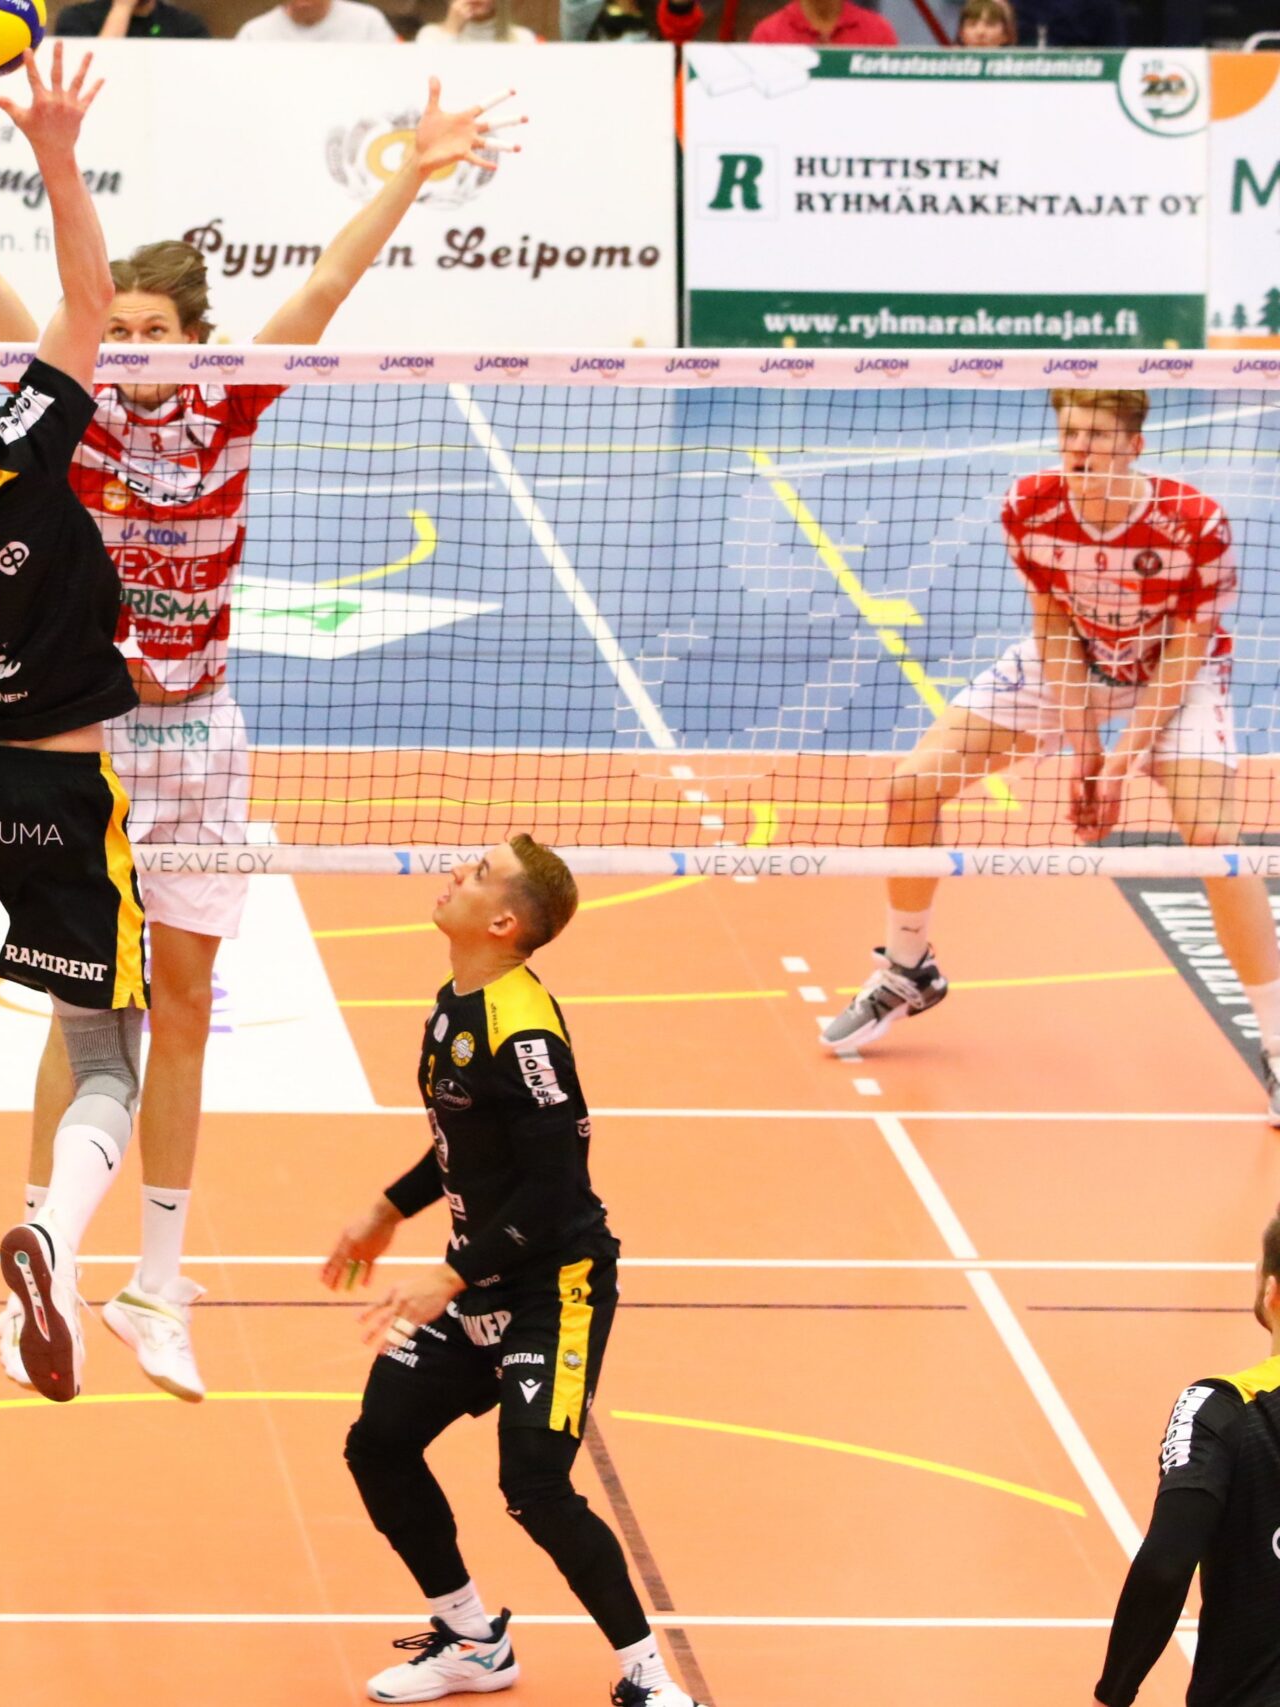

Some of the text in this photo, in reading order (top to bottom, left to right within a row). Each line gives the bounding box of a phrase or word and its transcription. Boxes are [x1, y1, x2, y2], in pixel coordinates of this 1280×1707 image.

[850, 54, 1104, 77] Korkeatasoista rakentamista
[794, 157, 1000, 179] HUITTISTEN
[709, 153, 764, 211] R
[794, 187, 1202, 216] RYHMÄRAKENTAJAT OY
[182, 219, 661, 279] Pyymn Leipomo
[763, 309, 1141, 337] www.ryhmarakentajat.fi
[96, 355, 150, 370] JACKON
[191, 356, 244, 371] JACKON
[286, 356, 339, 371] JACKON
[381, 357, 433, 372] JACKON
[475, 358, 528, 373] JACKON
[571, 359, 625, 374] JACKON
[667, 359, 719, 374] JACKON
[760, 359, 815, 374] JACKON
[854, 359, 909, 374] JACKON
[949, 359, 1004, 374] JACKON
[1043, 359, 1098, 374] JACKON
[1139, 359, 1194, 374] JACKON
[1094, 551, 1108, 572] 9
[139, 853, 274, 874] VEXVE OY
[694, 855, 828, 876] VEXVE OY
[971, 855, 1106, 877] VEXVE OY
[4, 943, 109, 983] RAMIRENT
